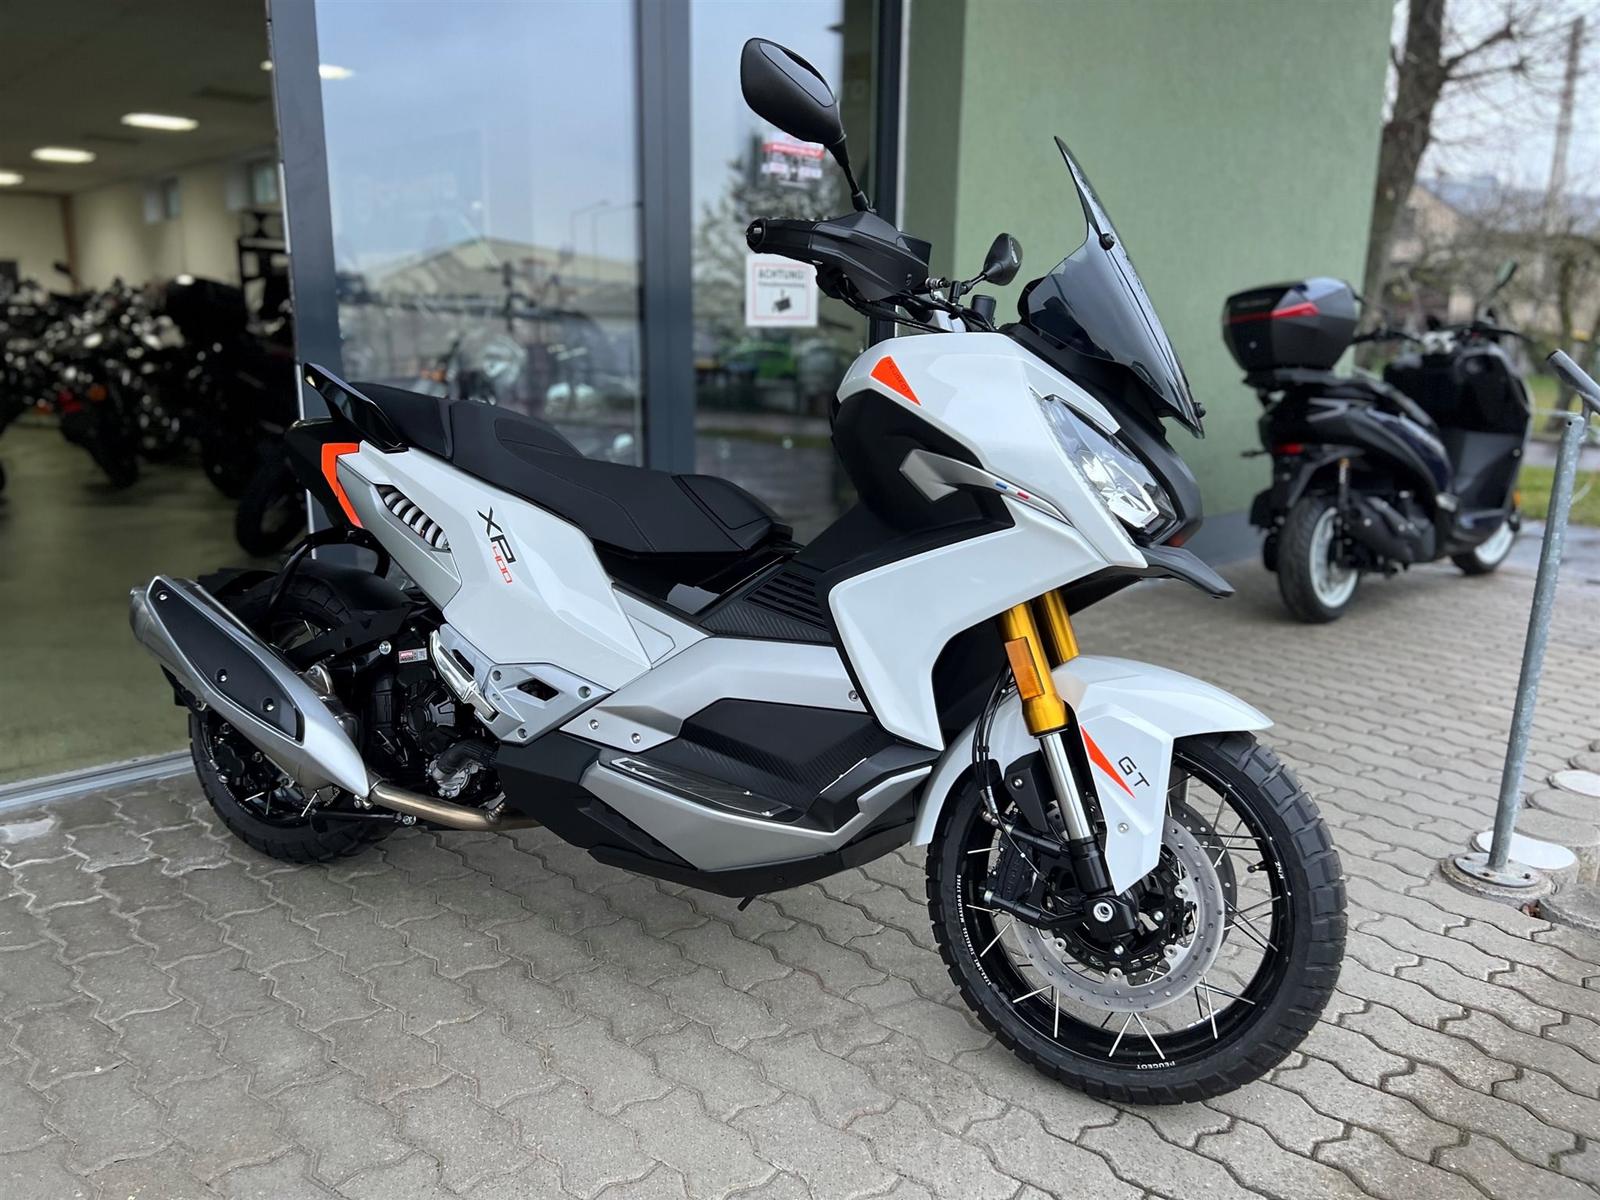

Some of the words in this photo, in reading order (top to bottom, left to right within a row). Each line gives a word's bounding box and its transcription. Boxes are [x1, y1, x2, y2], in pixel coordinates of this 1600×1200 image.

[476, 505, 517, 564] XP
[492, 545, 513, 584] 400
[1118, 756, 1150, 787] GT
[1136, 1061, 1176, 1071] PEUGEOT
